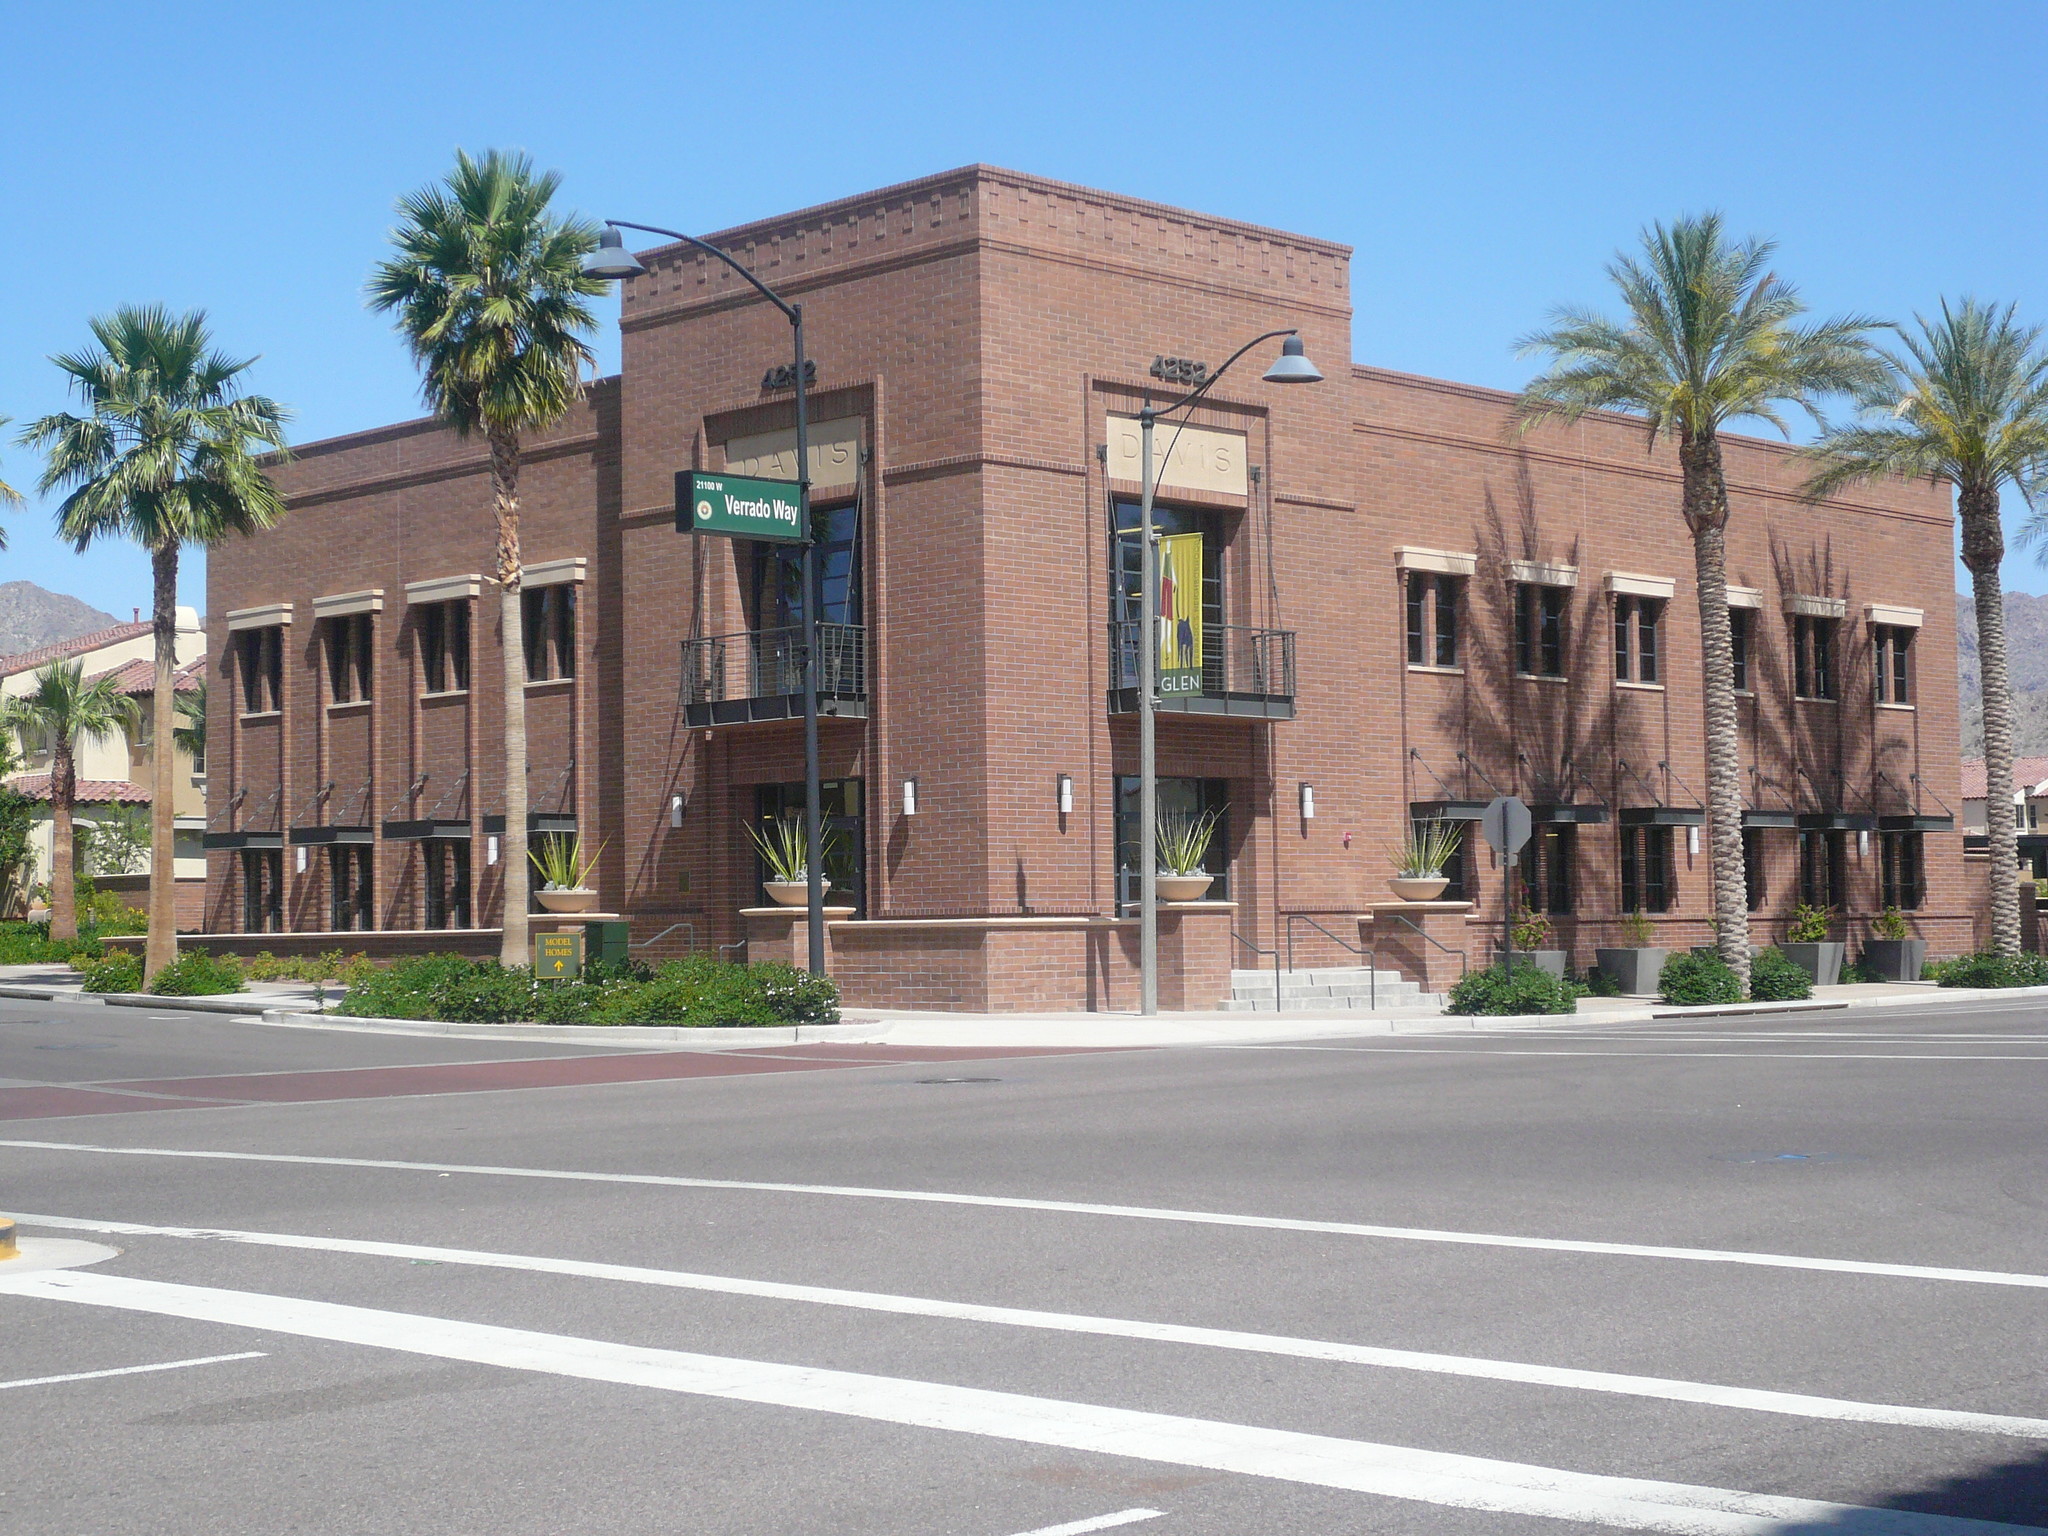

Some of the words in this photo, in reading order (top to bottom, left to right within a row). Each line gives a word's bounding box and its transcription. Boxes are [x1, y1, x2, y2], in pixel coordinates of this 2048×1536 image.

[1150, 355, 1208, 387] 4252
[1121, 433, 1232, 472] DAVIS
[696, 480, 715, 491] 21100
[715, 482, 723, 492] W
[724, 494, 771, 519] Verrado
[772, 499, 798, 526] Way
[1161, 676, 1200, 692] GLEN
[545, 937, 572, 946] MODEL
[545, 948, 572, 957] HOMES
